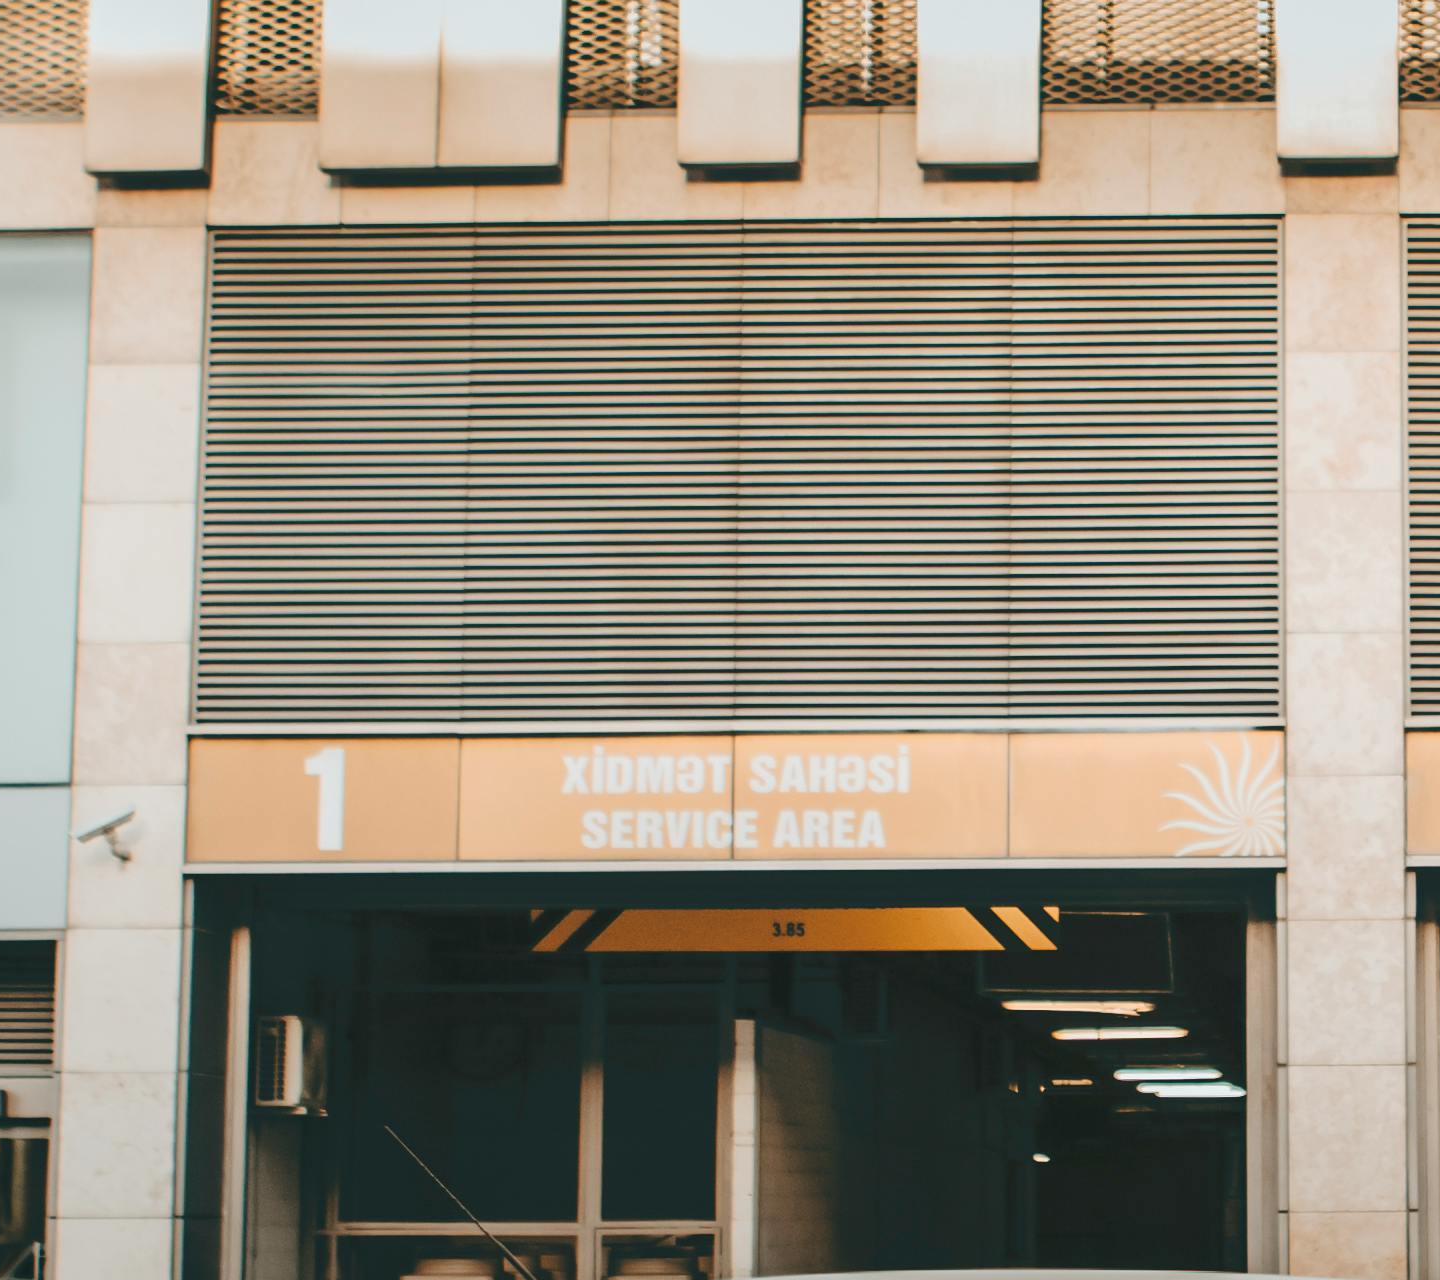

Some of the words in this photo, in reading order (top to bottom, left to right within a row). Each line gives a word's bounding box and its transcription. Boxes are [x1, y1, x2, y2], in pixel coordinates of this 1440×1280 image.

[562, 745, 731, 794] XİDMƏT
[749, 743, 911, 794] SAHƏSİ
[304, 747, 345, 851] 1
[582, 809, 758, 849] SERVICE
[773, 809, 887, 849] AREA
[771, 921, 806, 938] 3.85
